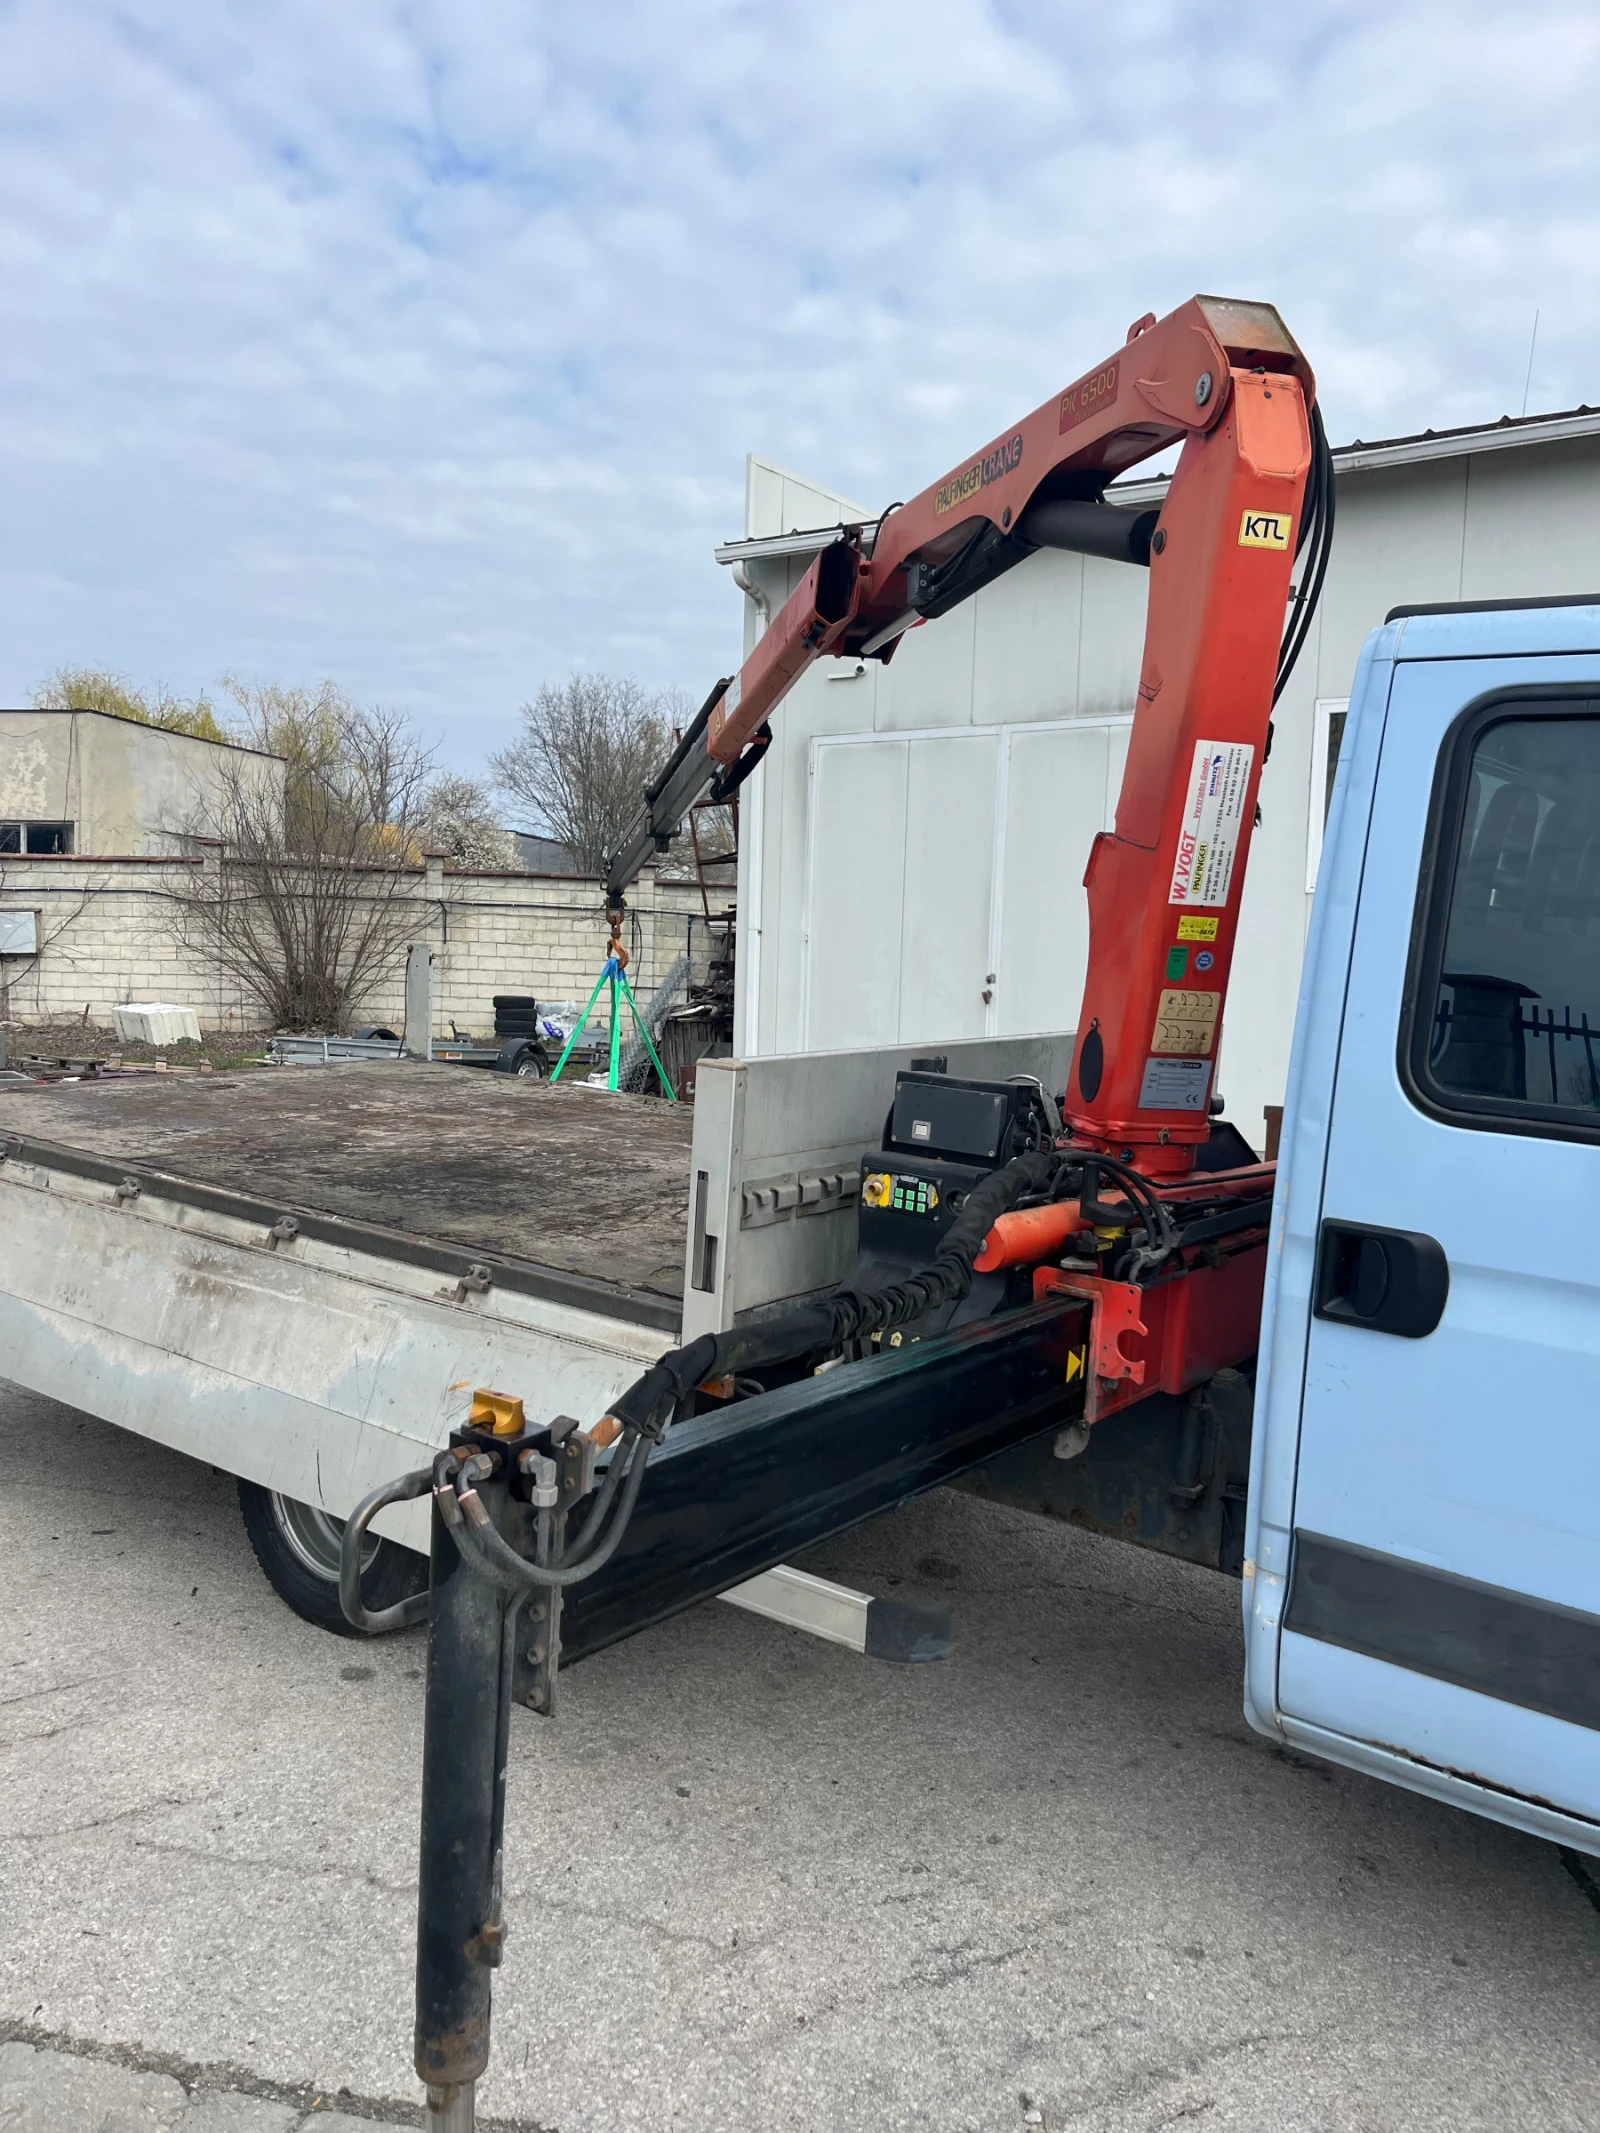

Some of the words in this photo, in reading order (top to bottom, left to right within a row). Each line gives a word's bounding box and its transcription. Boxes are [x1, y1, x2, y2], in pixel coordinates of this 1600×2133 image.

[1061, 394, 1076, 419] PK
[1082, 367, 1116, 405] 6500
[936, 464, 981, 513] PALFINGER
[982, 435, 1020, 480] CRANE
[1245, 516, 1284, 540] KTL
[1193, 782, 1206, 818] Vertriebs
[1200, 758, 1210, 780] GmbH
[1209, 766, 1218, 796] SCHMITZ
[1216, 809, 1224, 827] 37235
[1192, 844, 1208, 890] PALFINGER
